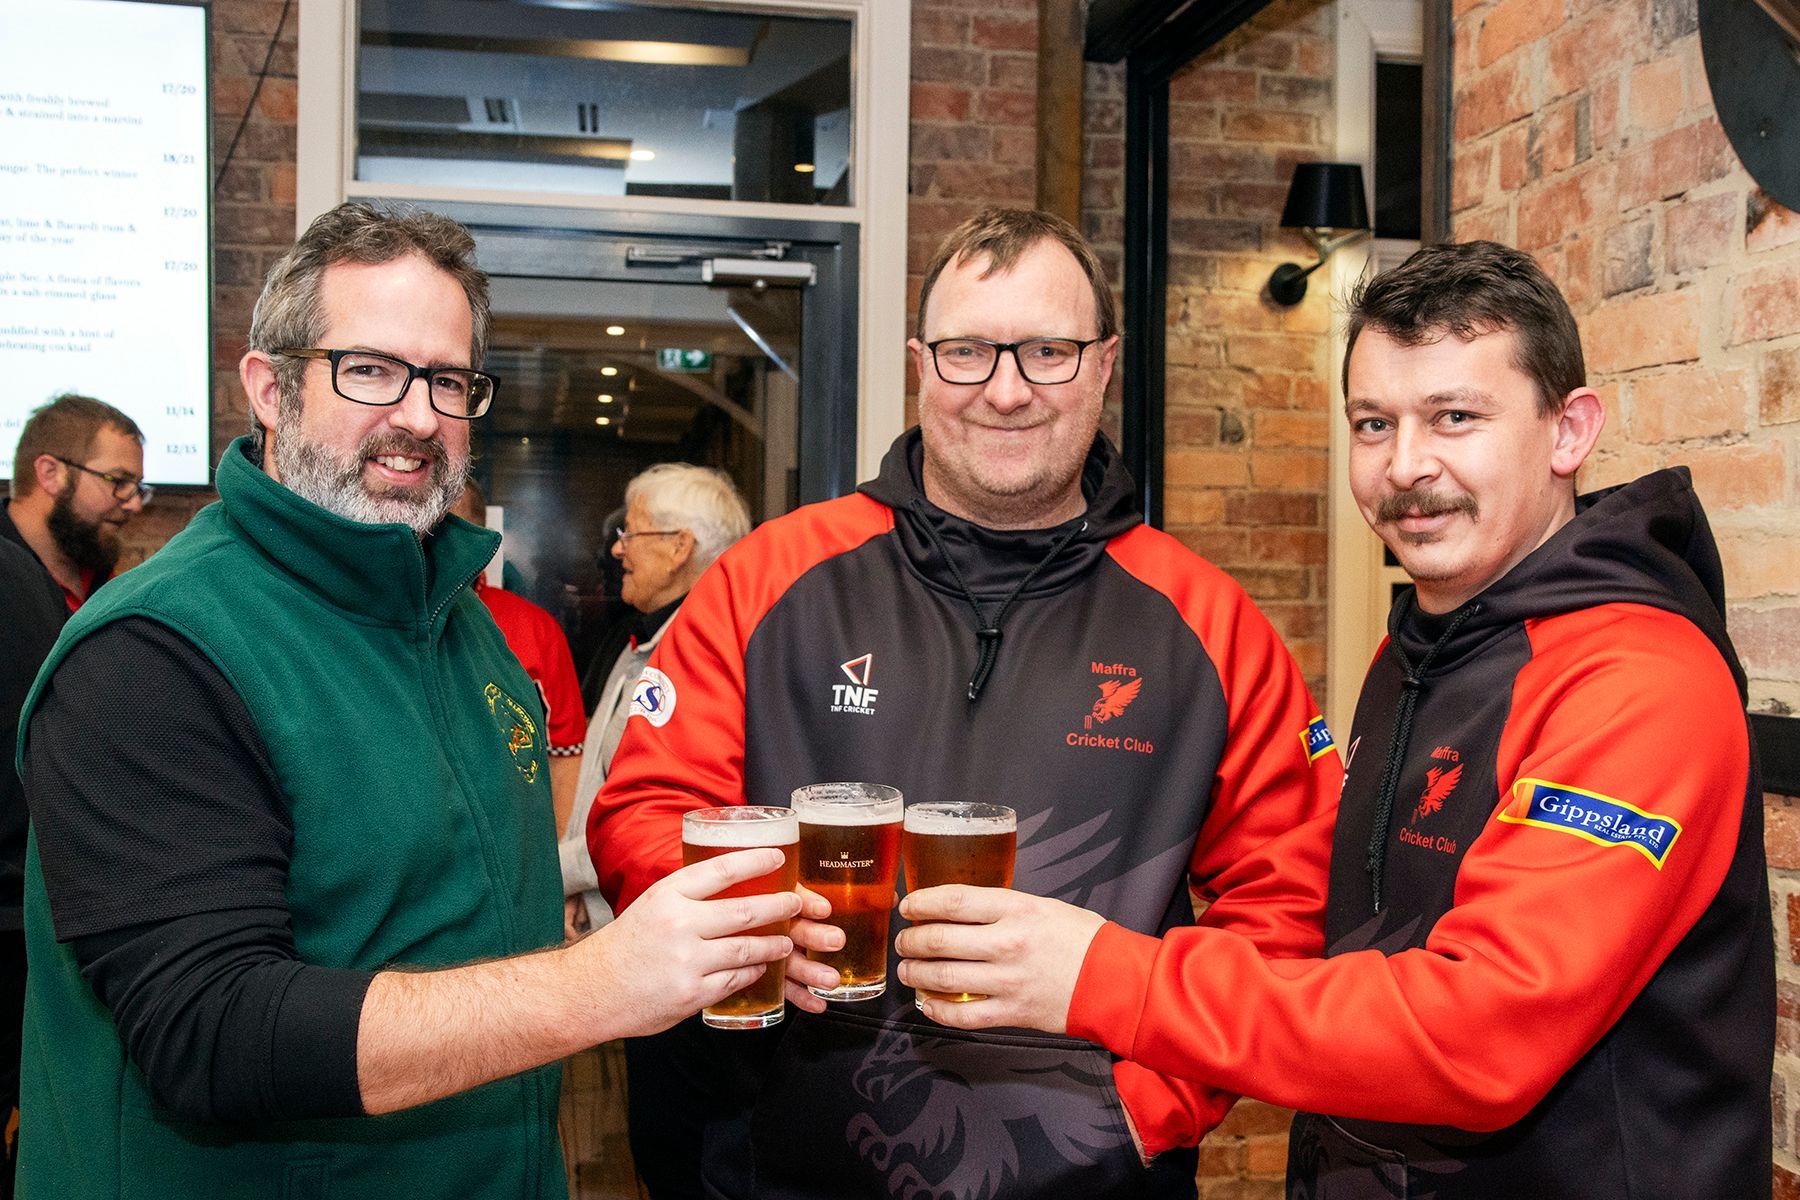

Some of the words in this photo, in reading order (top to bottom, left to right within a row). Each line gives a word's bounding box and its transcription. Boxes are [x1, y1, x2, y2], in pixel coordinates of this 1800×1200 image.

[1091, 661, 1137, 677] Maffra
[832, 684, 879, 708] TNF
[831, 705, 843, 713] TNF
[843, 706, 876, 715] CRICKET
[1066, 732, 1120, 749] Cricket
[1123, 737, 1154, 754] Club
[1539, 795, 1665, 844] Gippsland
[1400, 827, 1434, 849] Cricket
[1436, 836, 1457, 855] Club
